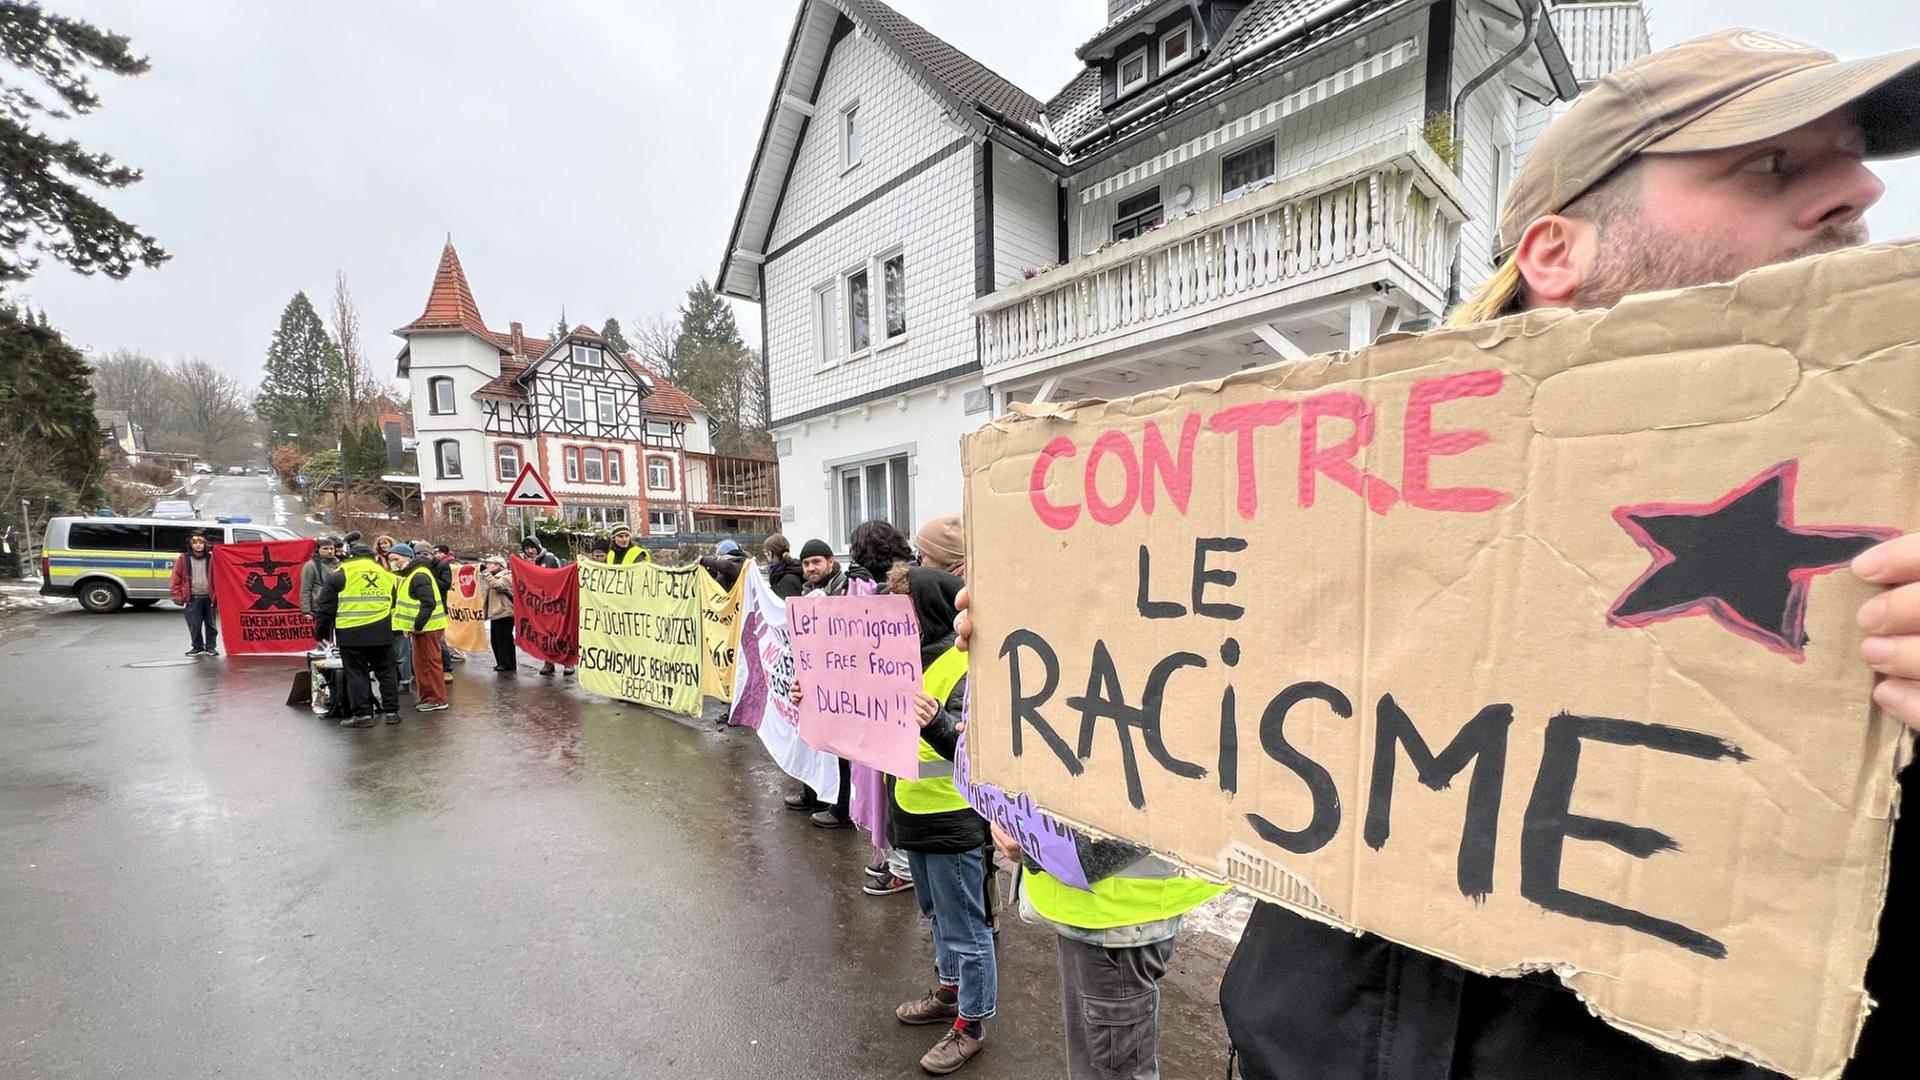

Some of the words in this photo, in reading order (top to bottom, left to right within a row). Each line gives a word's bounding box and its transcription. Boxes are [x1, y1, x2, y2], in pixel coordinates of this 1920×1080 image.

[1029, 369, 1515, 531] CONTRE
[641, 570, 664, 598] AUF
[1137, 536, 1249, 620] LE
[791, 604, 818, 636] Let
[825, 651, 857, 669] FREE
